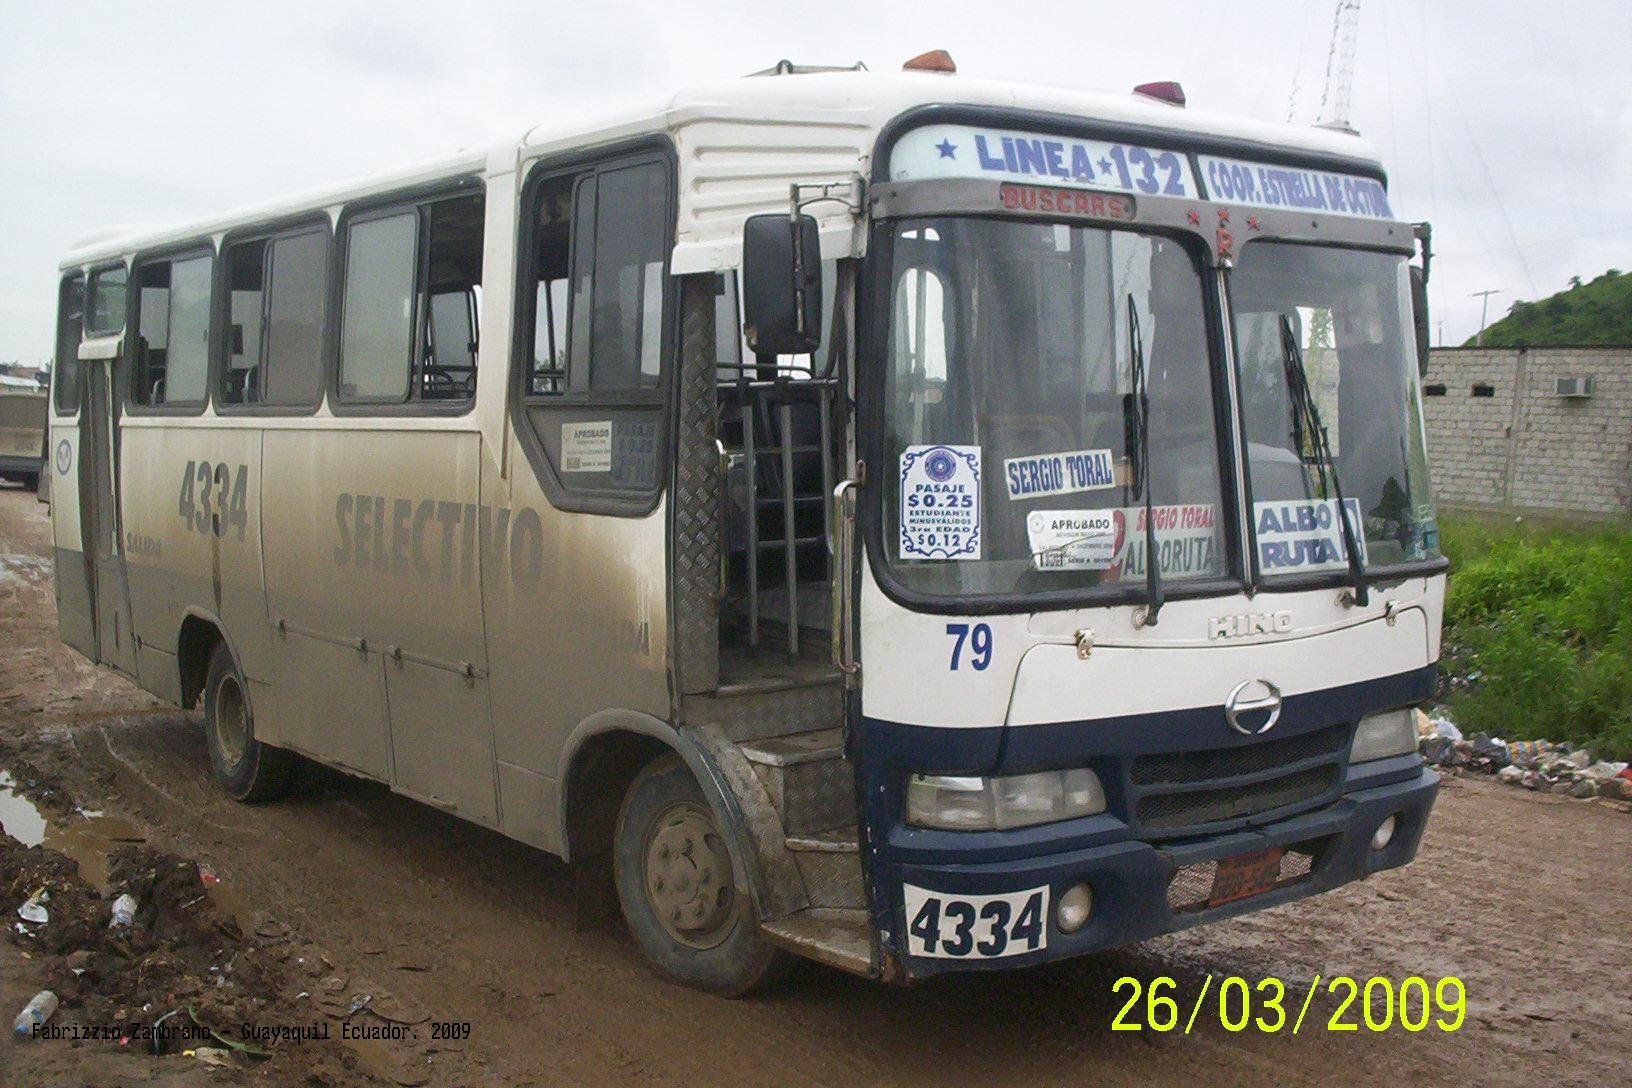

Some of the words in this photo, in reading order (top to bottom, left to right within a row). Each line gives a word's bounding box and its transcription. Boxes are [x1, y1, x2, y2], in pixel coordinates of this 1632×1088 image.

[1109, 145, 1195, 196] 132
[1208, 161, 1262, 203] COOP.
[915, 484, 966, 493] PASAJE
[1008, 457, 1064, 495] SERGIO
[1065, 453, 1113, 488] TORAL
[179, 461, 248, 542] 4334
[908, 494, 973, 508] $0.25
[334, 492, 543, 588] SELECTIVO
[918, 534, 961, 547] $0.12
[1051, 519, 1110, 530] APROBADO
[1123, 537, 1220, 575] ALORUTA
[1208, 610, 1293, 639] HINO
[946, 623, 993, 671] 79
[911, 892, 1043, 957] 4334
